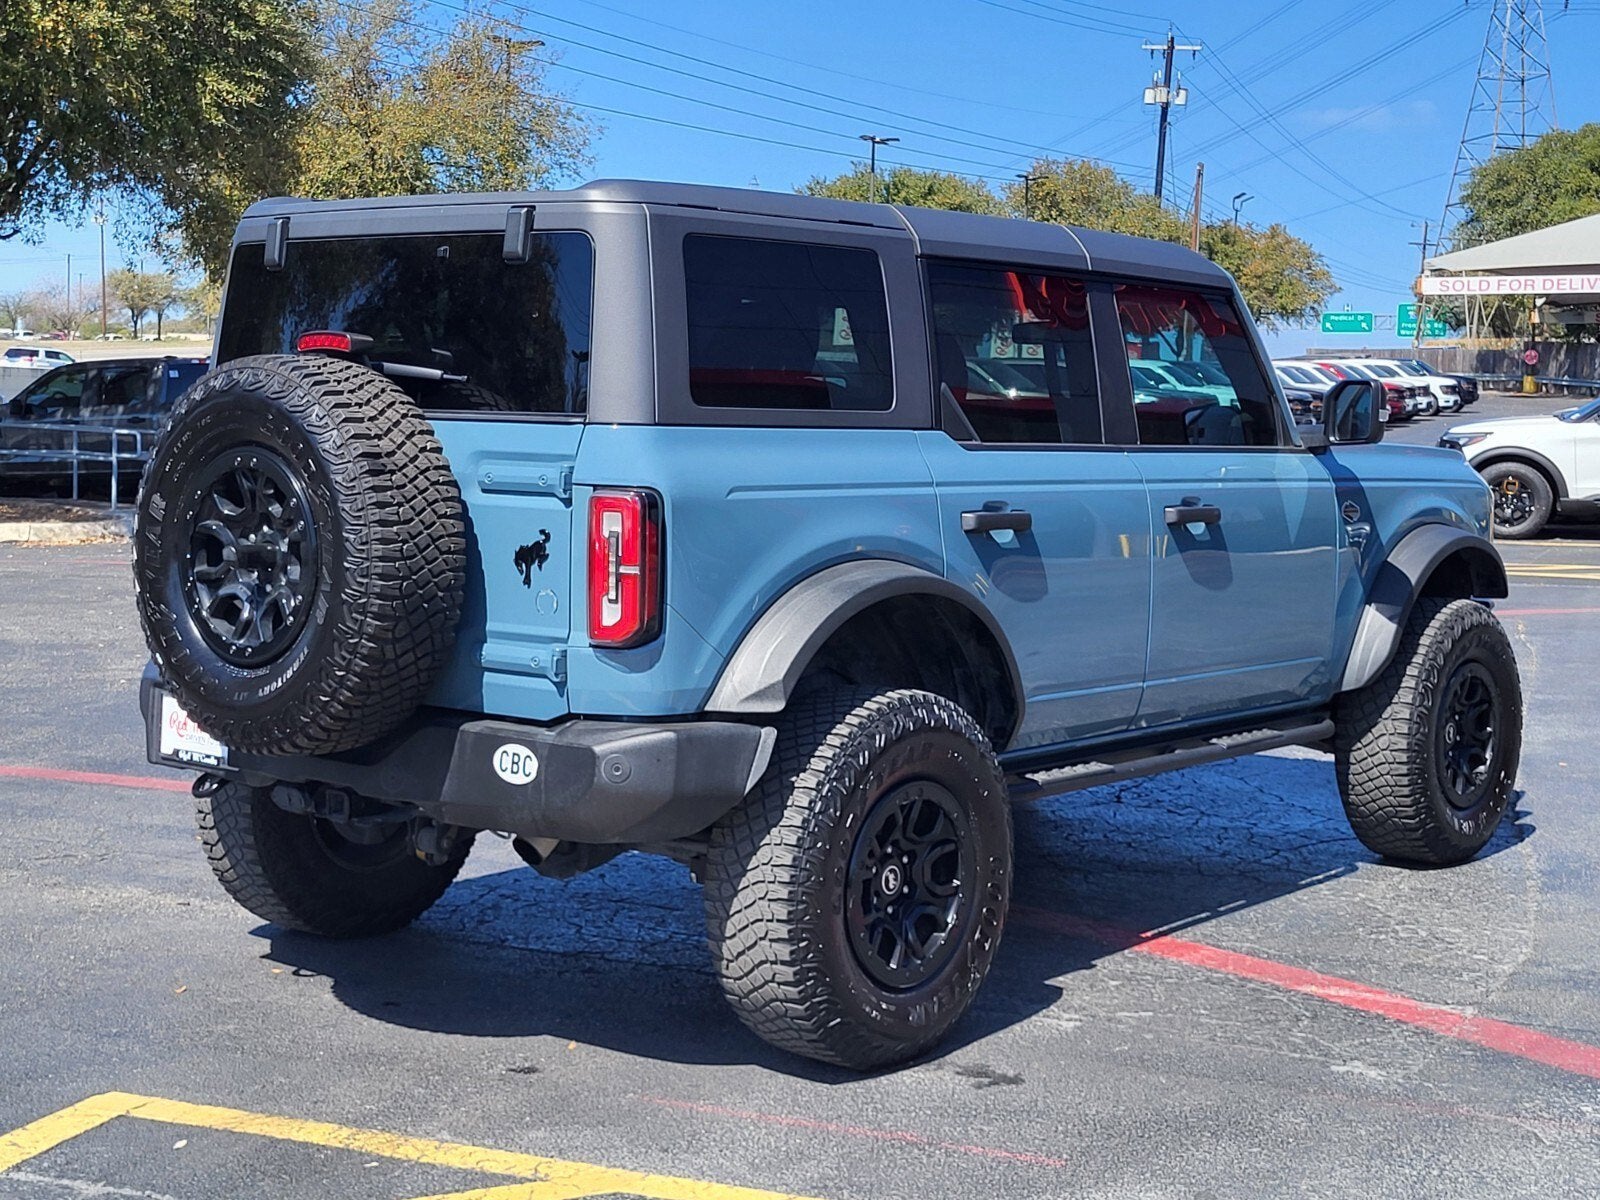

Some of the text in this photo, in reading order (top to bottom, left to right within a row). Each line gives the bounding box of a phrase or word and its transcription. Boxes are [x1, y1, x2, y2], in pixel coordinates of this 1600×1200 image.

[1439, 277, 1600, 293] SOLD FOR DELIV
[499, 750, 533, 778] CBC
